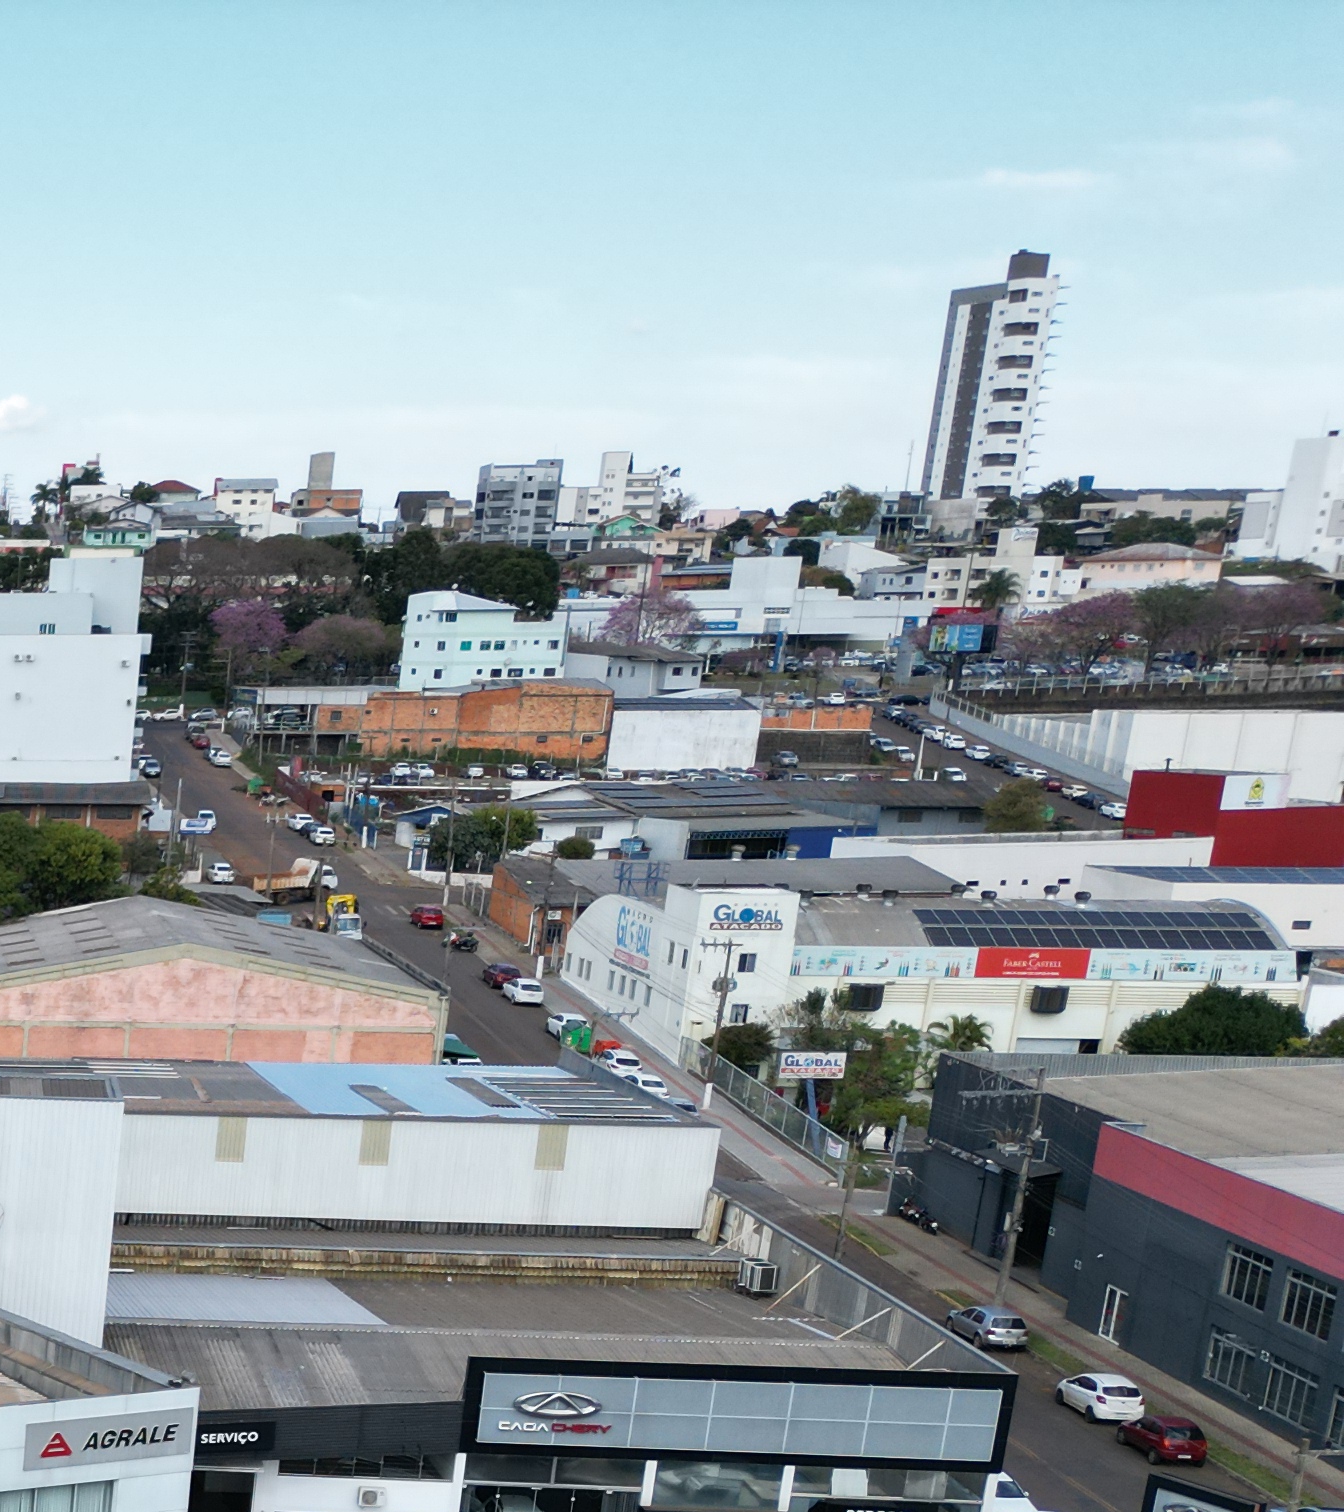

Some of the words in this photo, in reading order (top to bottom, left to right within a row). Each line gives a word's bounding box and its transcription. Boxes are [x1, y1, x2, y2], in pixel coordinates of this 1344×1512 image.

[713, 904, 783, 922] GLOBAL
[616, 906, 652, 957] GLOBAL
[784, 1055, 842, 1067] GLOBAL
[83, 1423, 180, 1451] AGRALE
[200, 1431, 259, 1446] SERVIÇO
